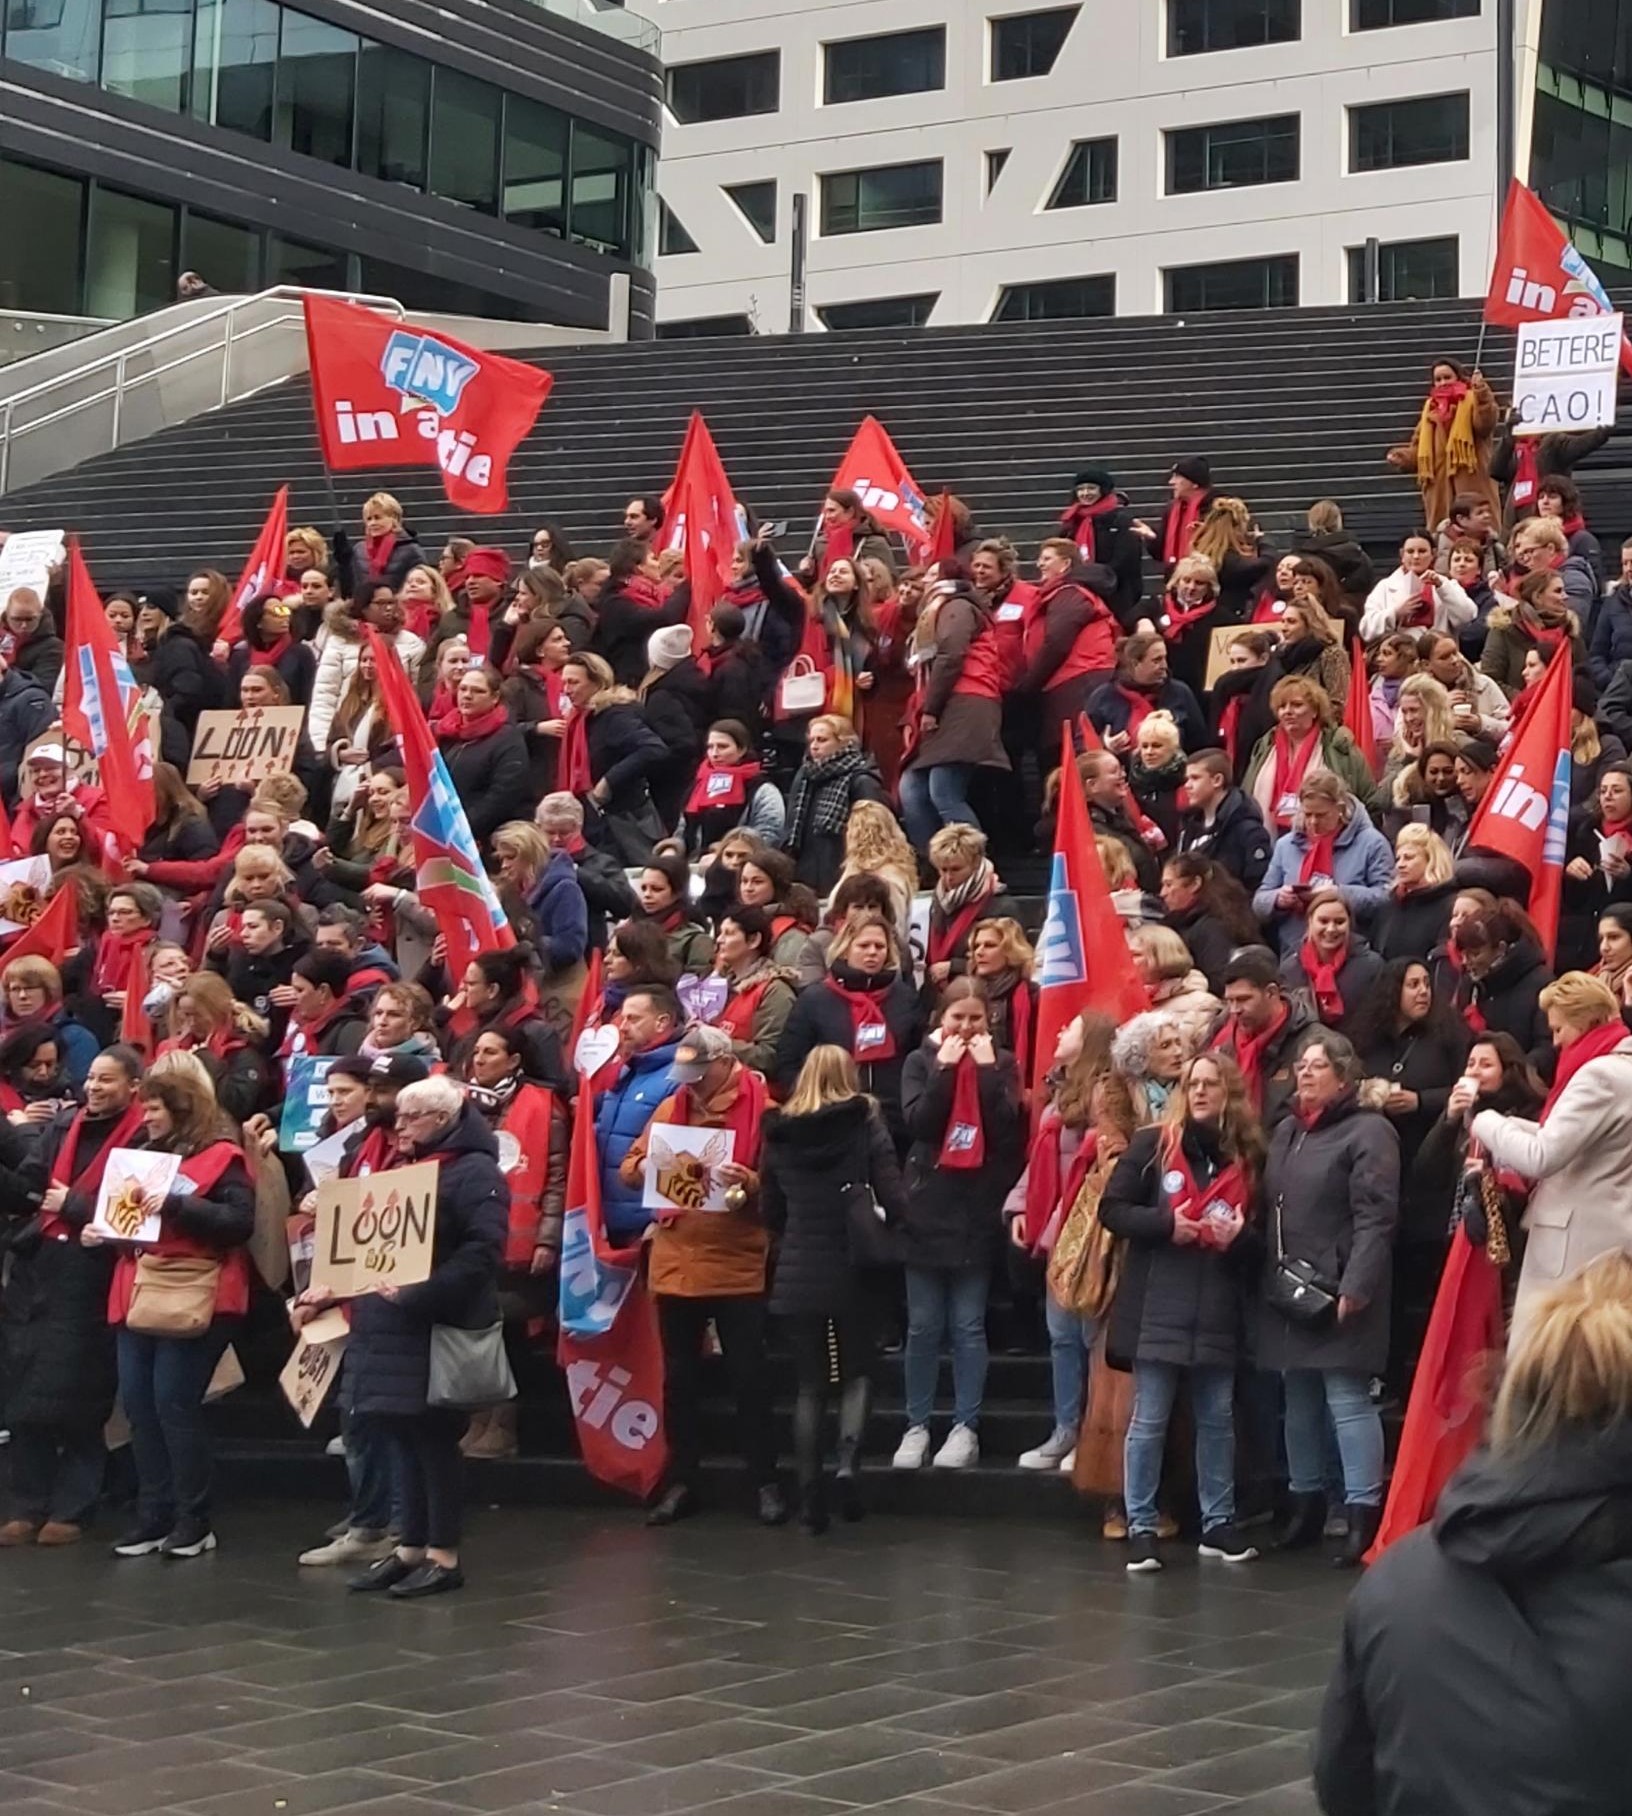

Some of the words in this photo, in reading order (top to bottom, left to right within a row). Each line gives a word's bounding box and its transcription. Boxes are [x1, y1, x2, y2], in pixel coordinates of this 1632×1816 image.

[1505, 267, 1556, 313] in
[385, 346, 472, 397] FNV
[1520, 332, 1617, 369] BETERE
[1518, 390, 1602, 424] CAO!
[334, 401, 399, 443] in
[417, 410, 492, 487] atie
[852, 478, 901, 511] in
[194, 726, 287, 761] LOON
[1490, 763, 1549, 832] in
[330, 1191, 431, 1265] LOON
[566, 1358, 658, 1450] tie
